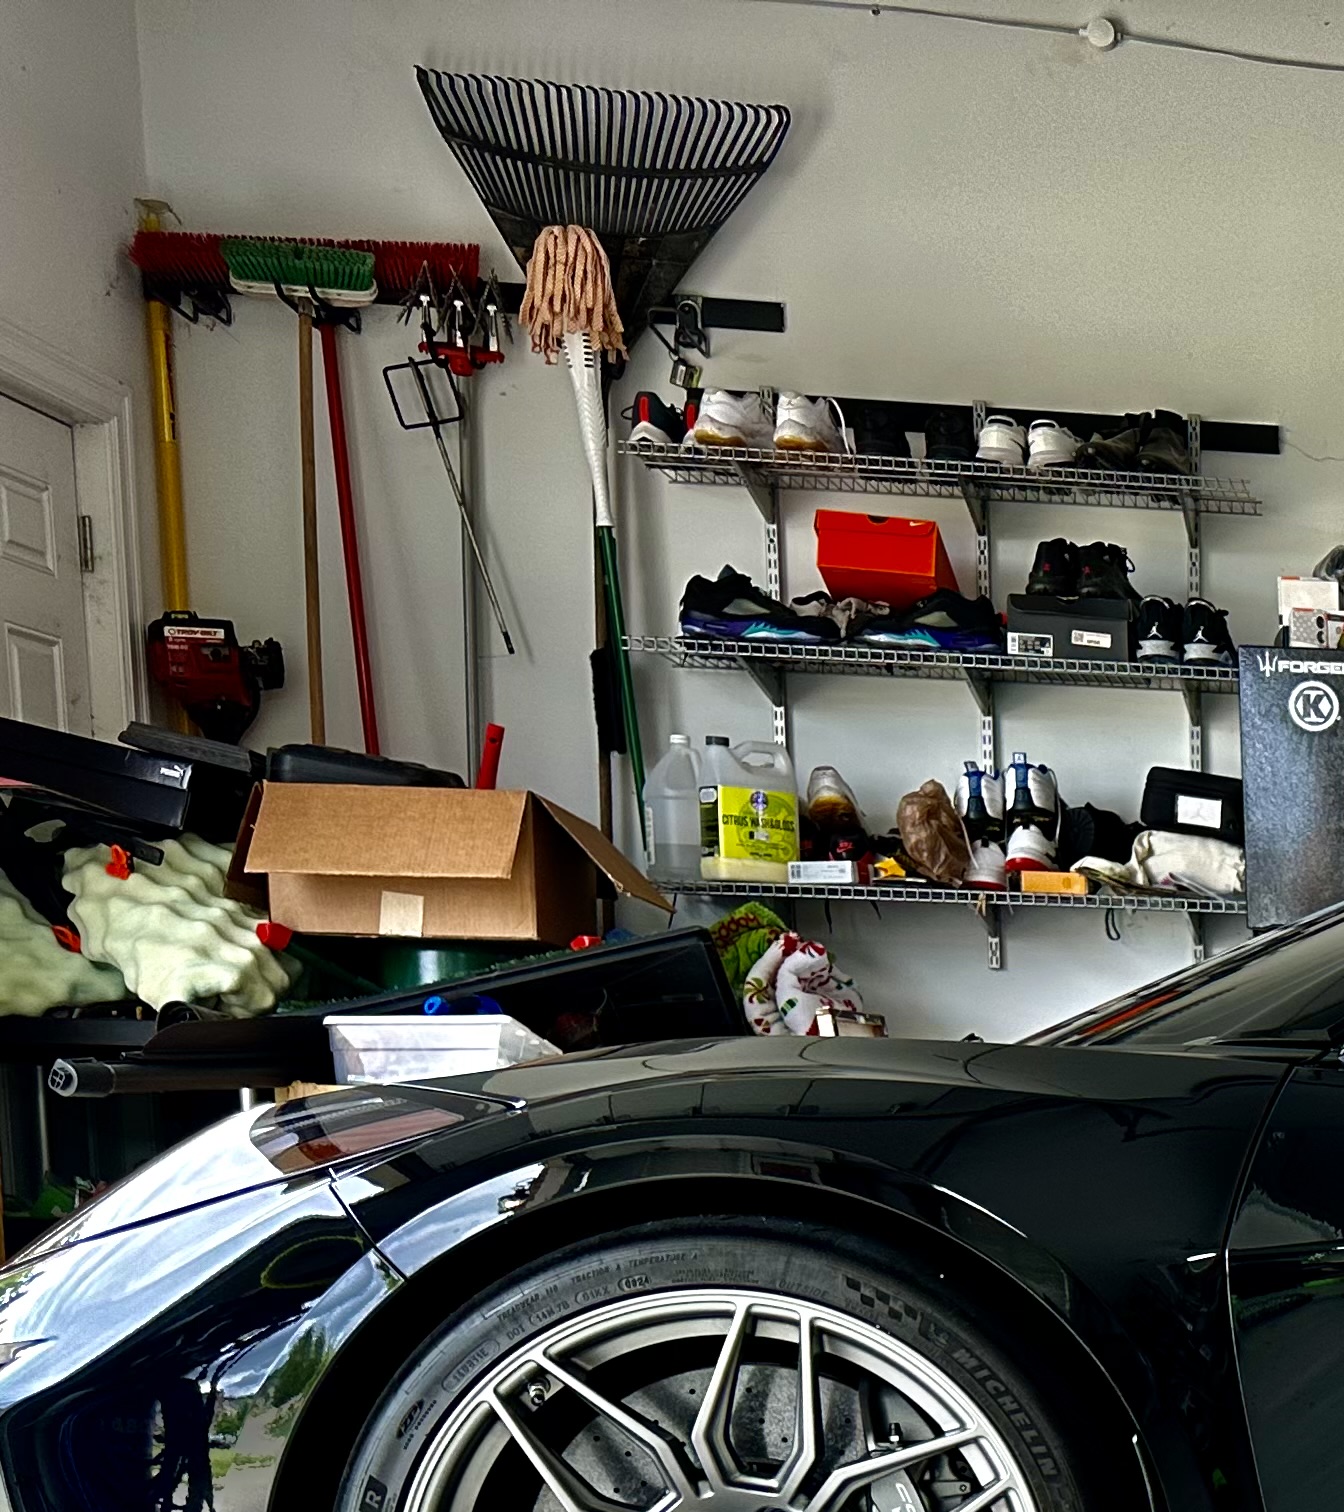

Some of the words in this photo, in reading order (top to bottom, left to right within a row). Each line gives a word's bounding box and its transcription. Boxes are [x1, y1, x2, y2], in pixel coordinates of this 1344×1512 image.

[722, 814, 749, 827] CITRUS
[571, 1266, 610, 1284] TRACTION
[629, 1253, 687, 1269] TEMPERATURE
[778, 1279, 829, 1299] OUTSIDE
[953, 1348, 1059, 1476] MICHELIN
